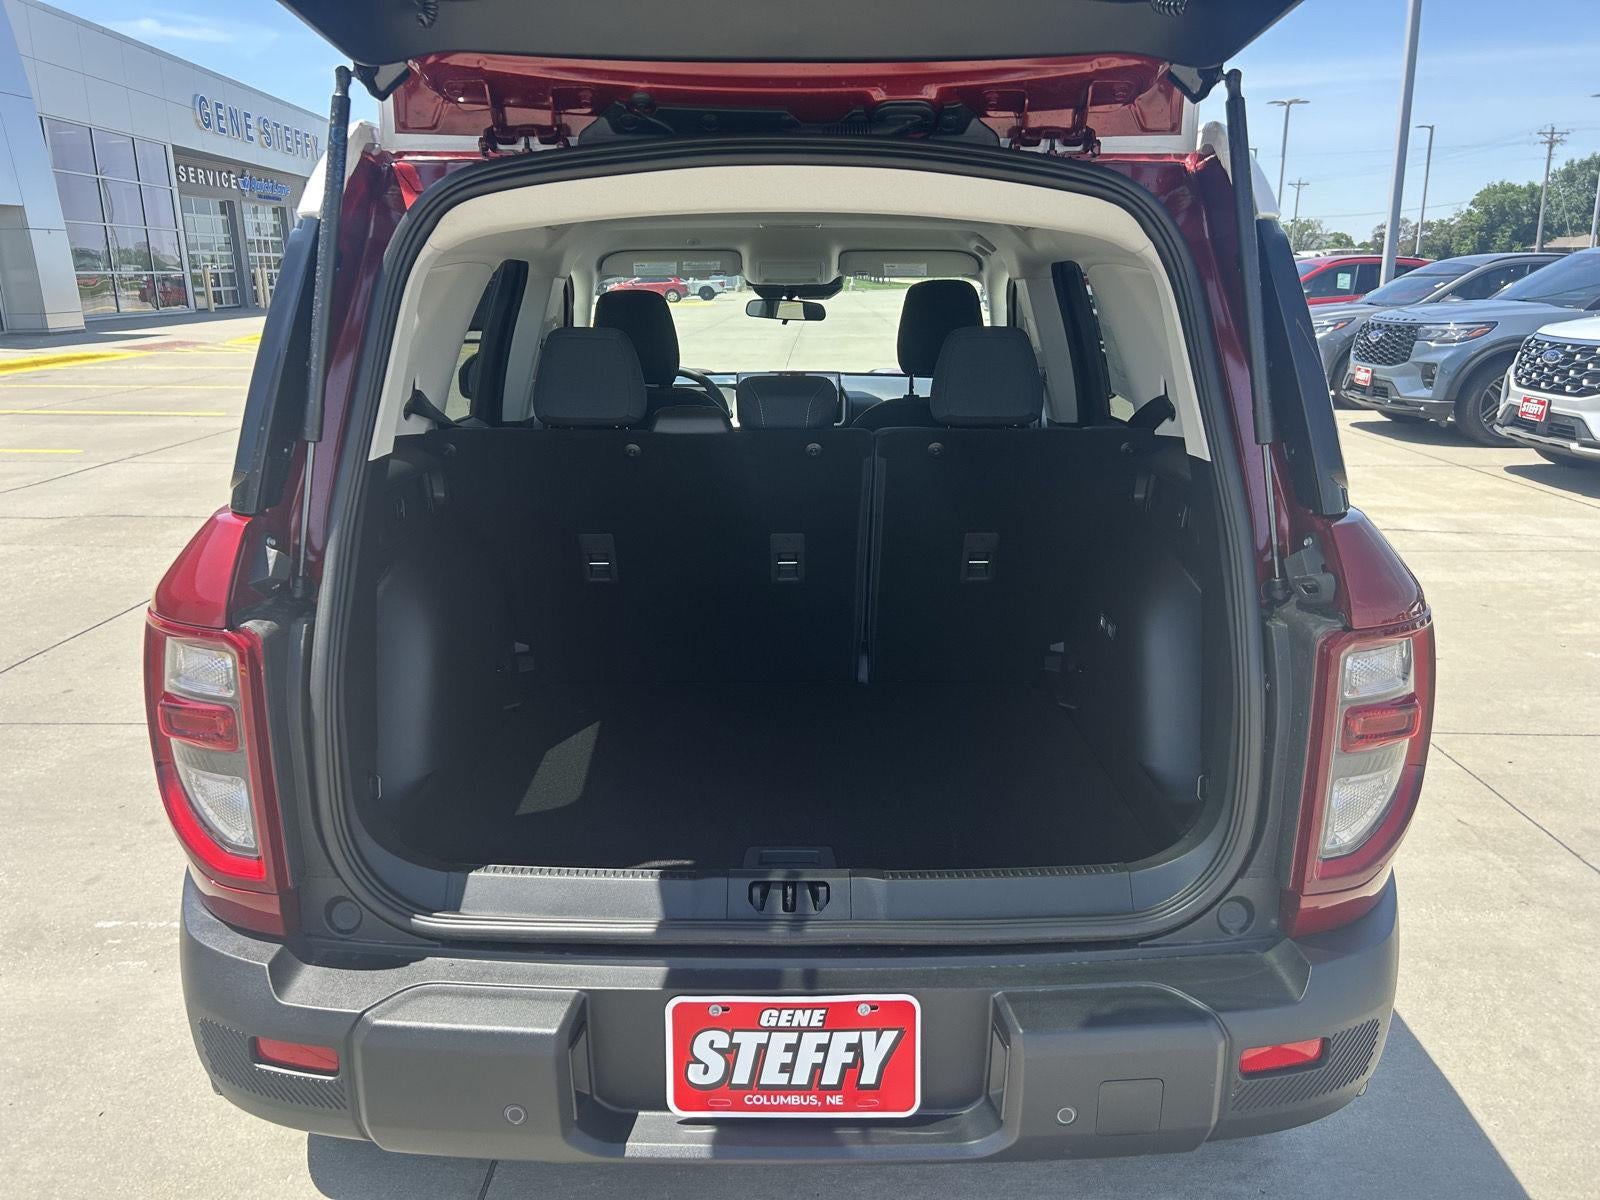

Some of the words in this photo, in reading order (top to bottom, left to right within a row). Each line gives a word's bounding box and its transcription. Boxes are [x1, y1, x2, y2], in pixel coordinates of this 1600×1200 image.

[194, 94, 255, 143] GENE
[259, 115, 319, 160] STEFFY
[178, 164, 238, 189] SERVICE
[759, 1007, 829, 1029] GENE
[685, 1028, 906, 1091] STEFFY
[743, 1094, 822, 1107] COLUMBUS,
[826, 1095, 844, 1105] NE
